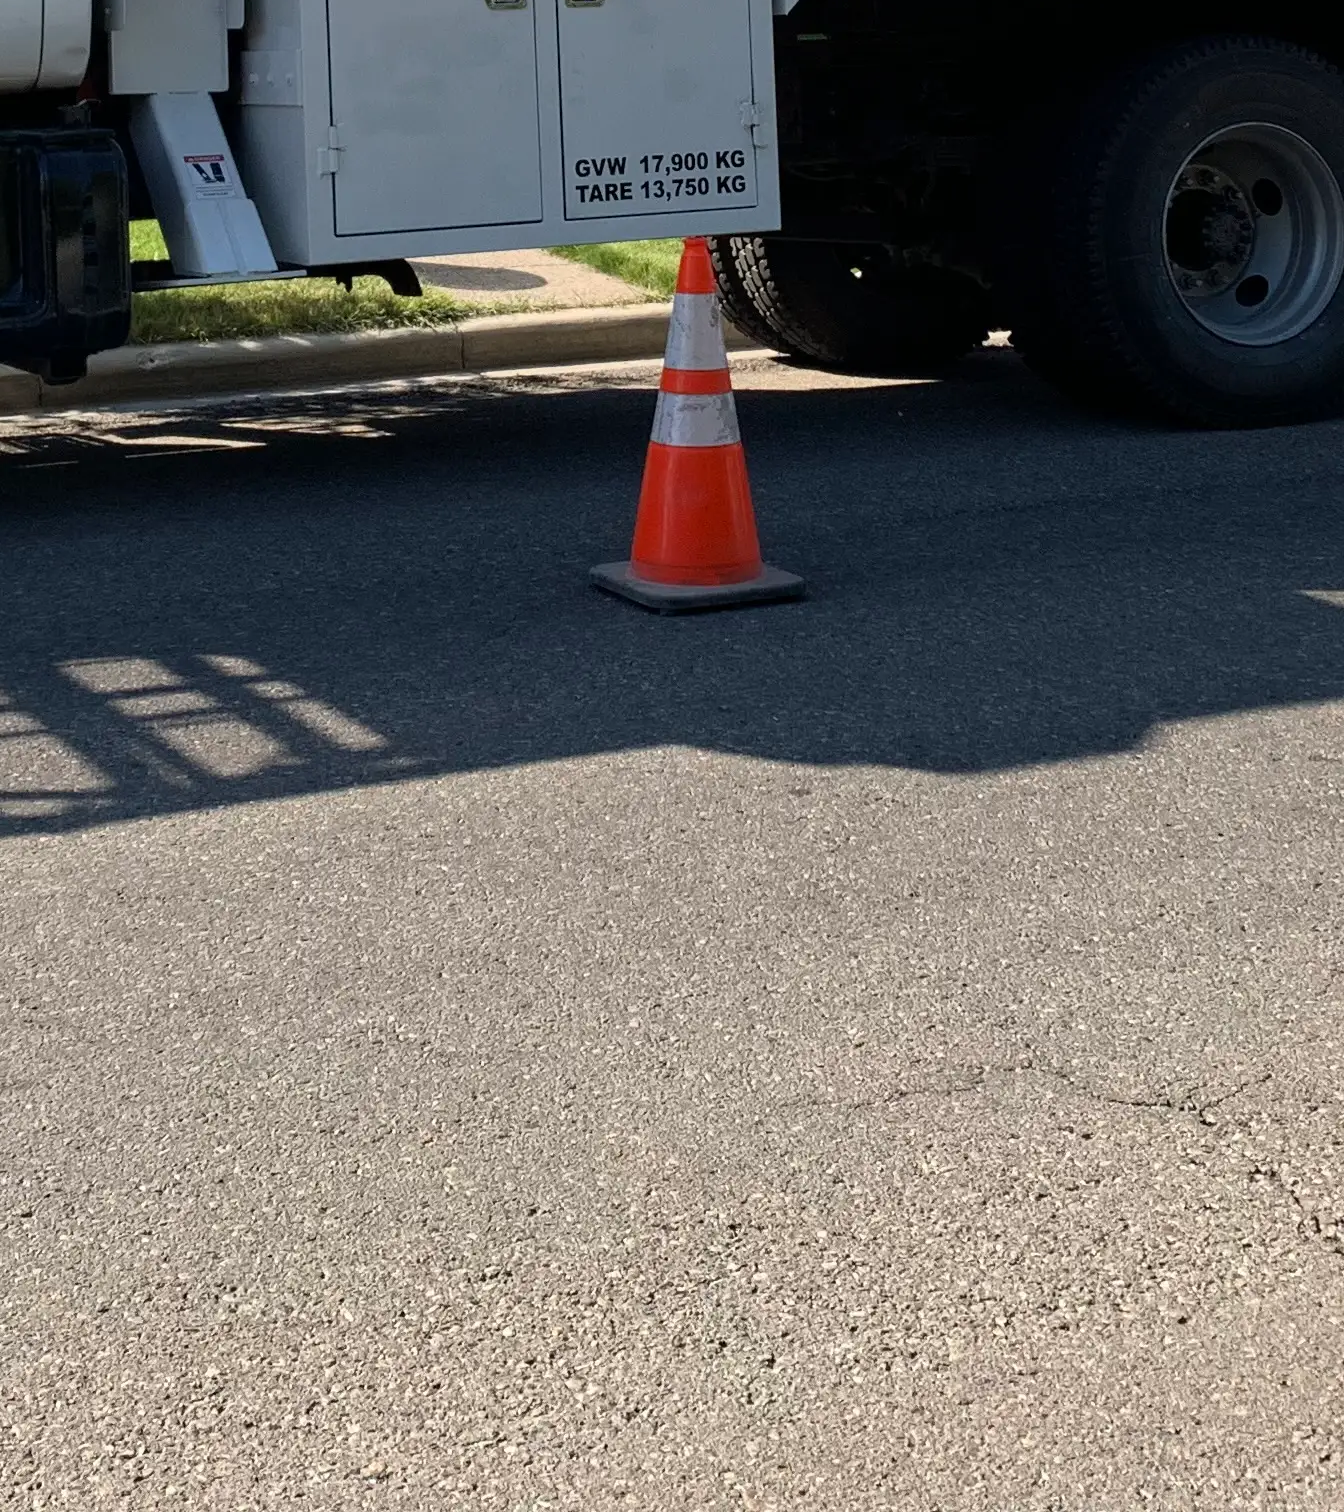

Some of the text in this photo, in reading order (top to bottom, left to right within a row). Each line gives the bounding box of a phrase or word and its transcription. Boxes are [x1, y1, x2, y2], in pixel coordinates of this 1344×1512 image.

[574, 149, 745, 178] GVW 17,900 KG
[575, 175, 747, 203] TARE 13,750 KG
